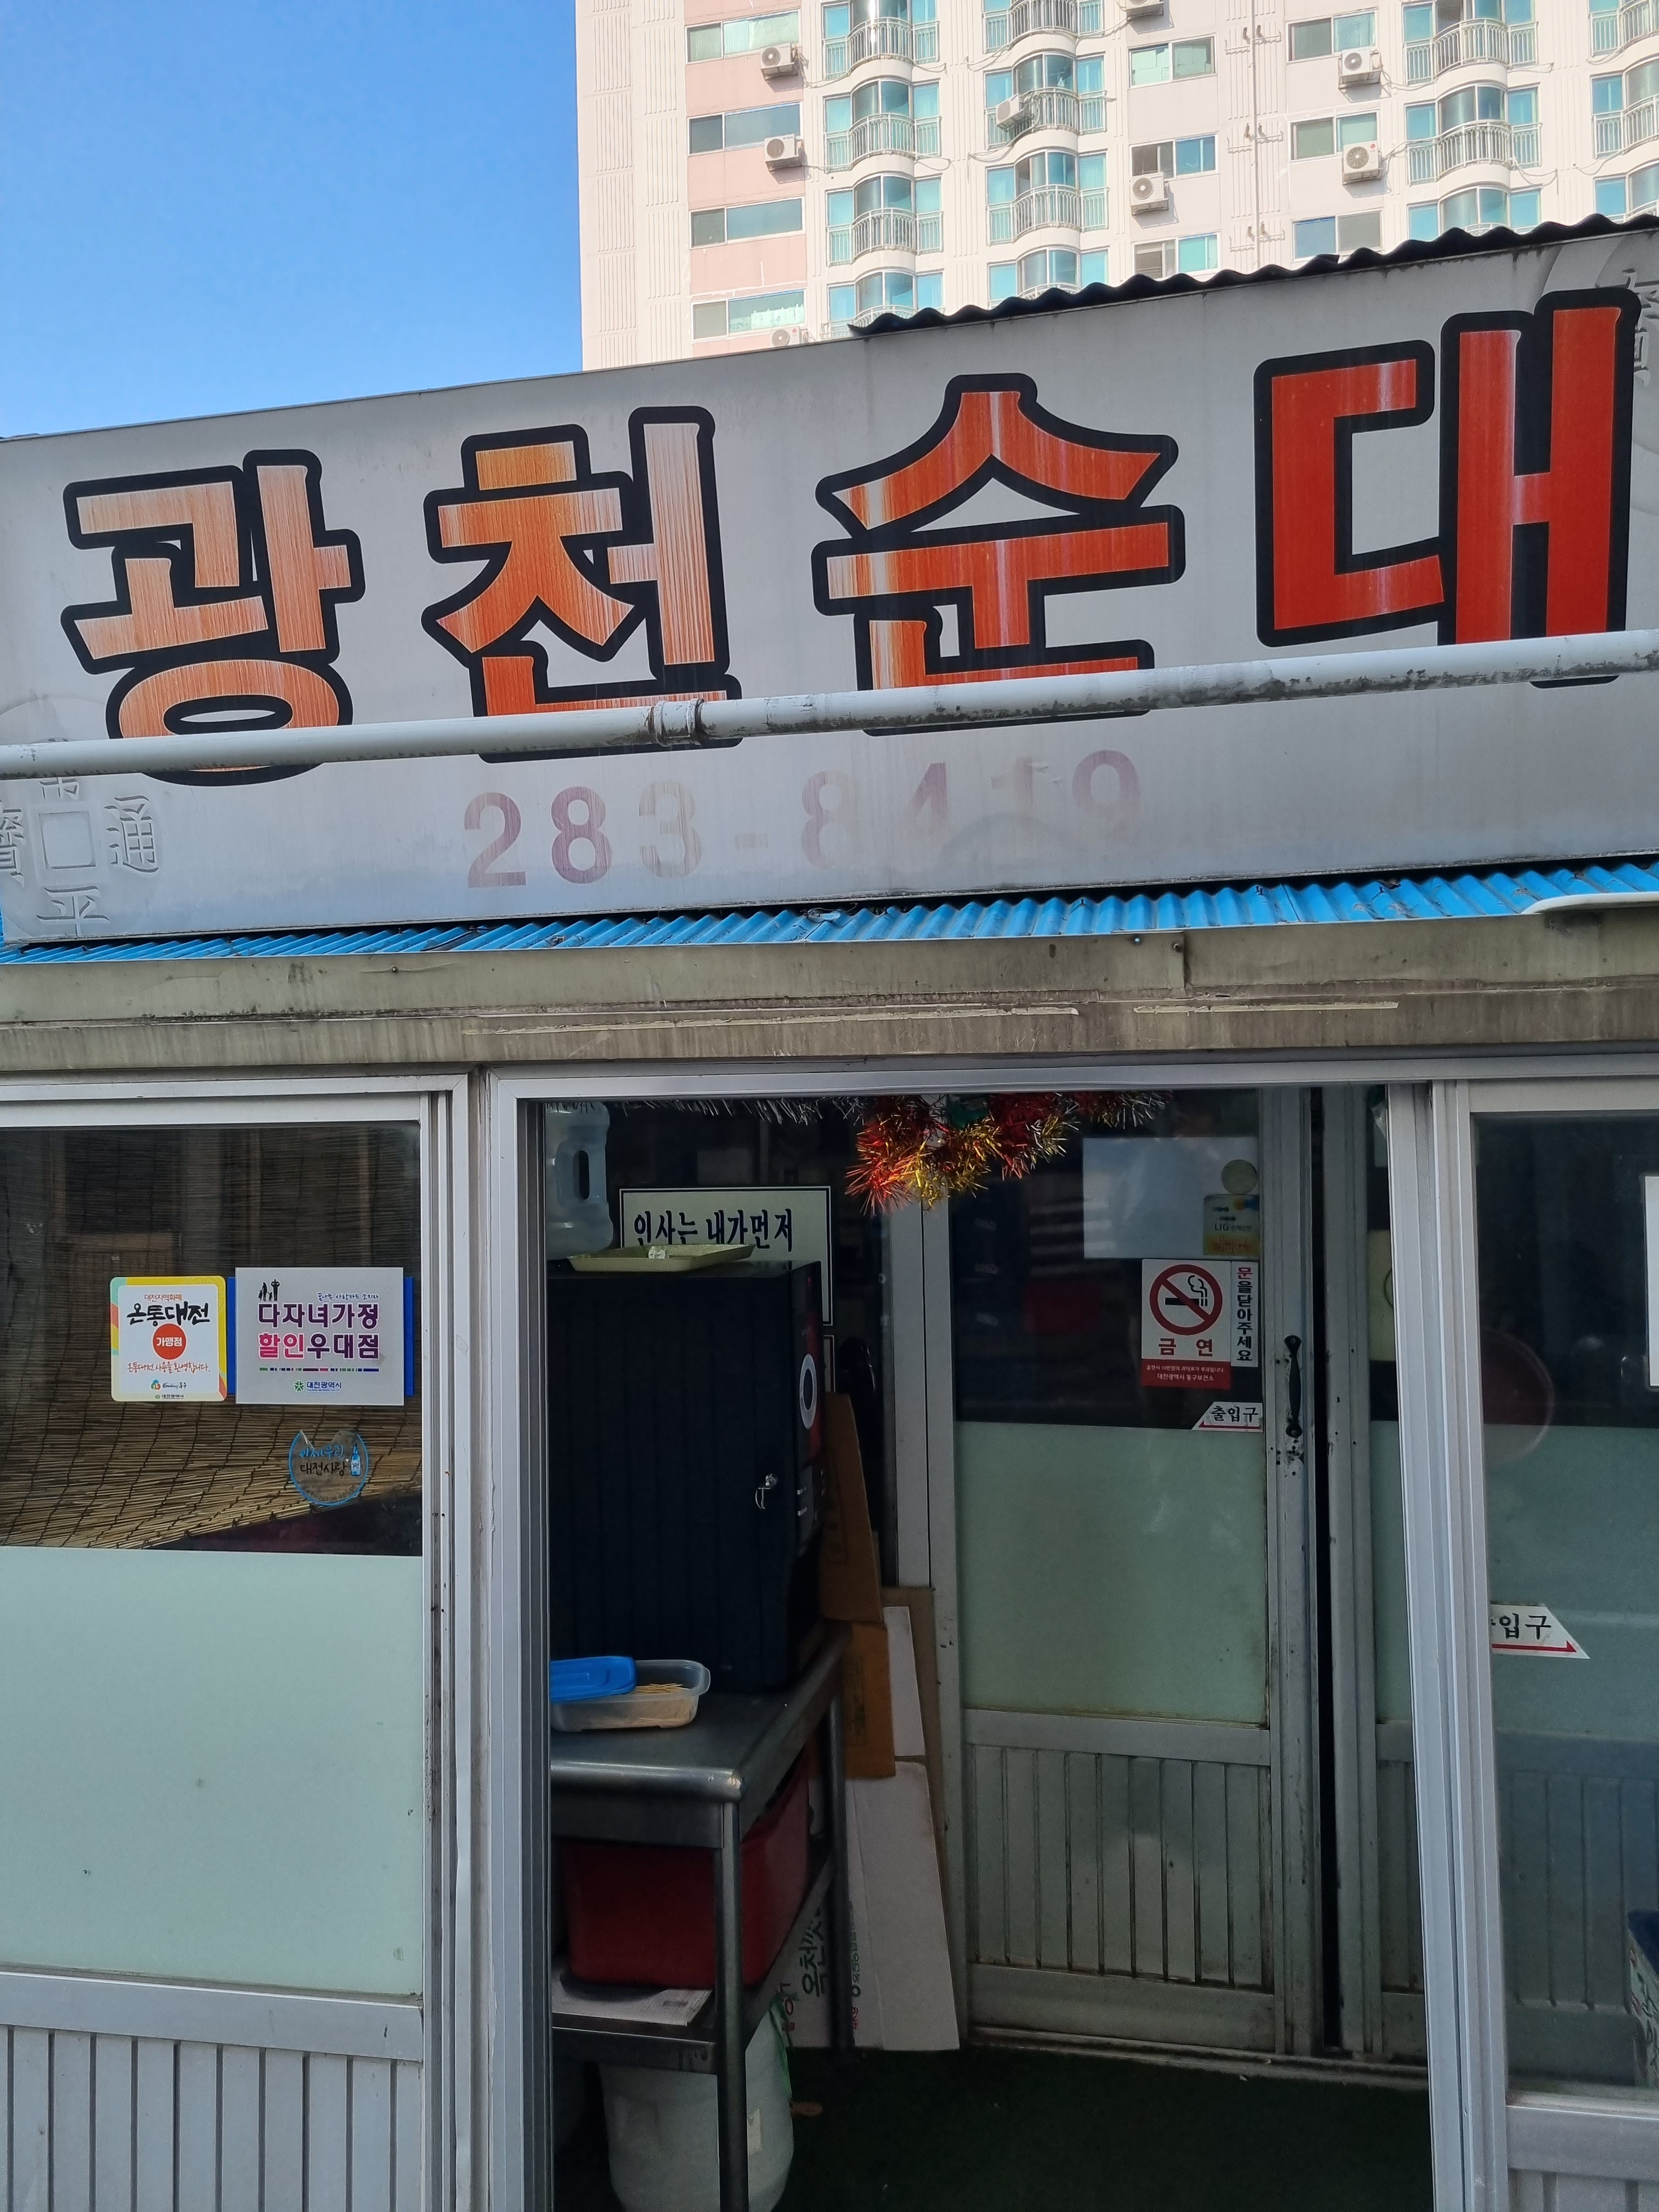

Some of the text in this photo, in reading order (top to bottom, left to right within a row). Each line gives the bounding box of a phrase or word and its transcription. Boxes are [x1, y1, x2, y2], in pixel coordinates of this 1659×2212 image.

[61, 287, 1640, 787] 광천순대
[634, 1210, 698, 1245] 인사는
[144, 1294, 182, 1302] 대전지역화폐
[127, 1301, 210, 1327] 온통대전
[258, 1304, 379, 1329] 다자녀가정
[156, 1336, 182, 1347] 가맹점
[259, 1333, 379, 1359] 할인우대점
[127, 1362, 154, 1373] 온통대전
[155, 1361, 173, 1373] 사용을
[1211, 1406, 1259, 1423] 출입구
[300, 1462, 347, 1476] 대전사랑
